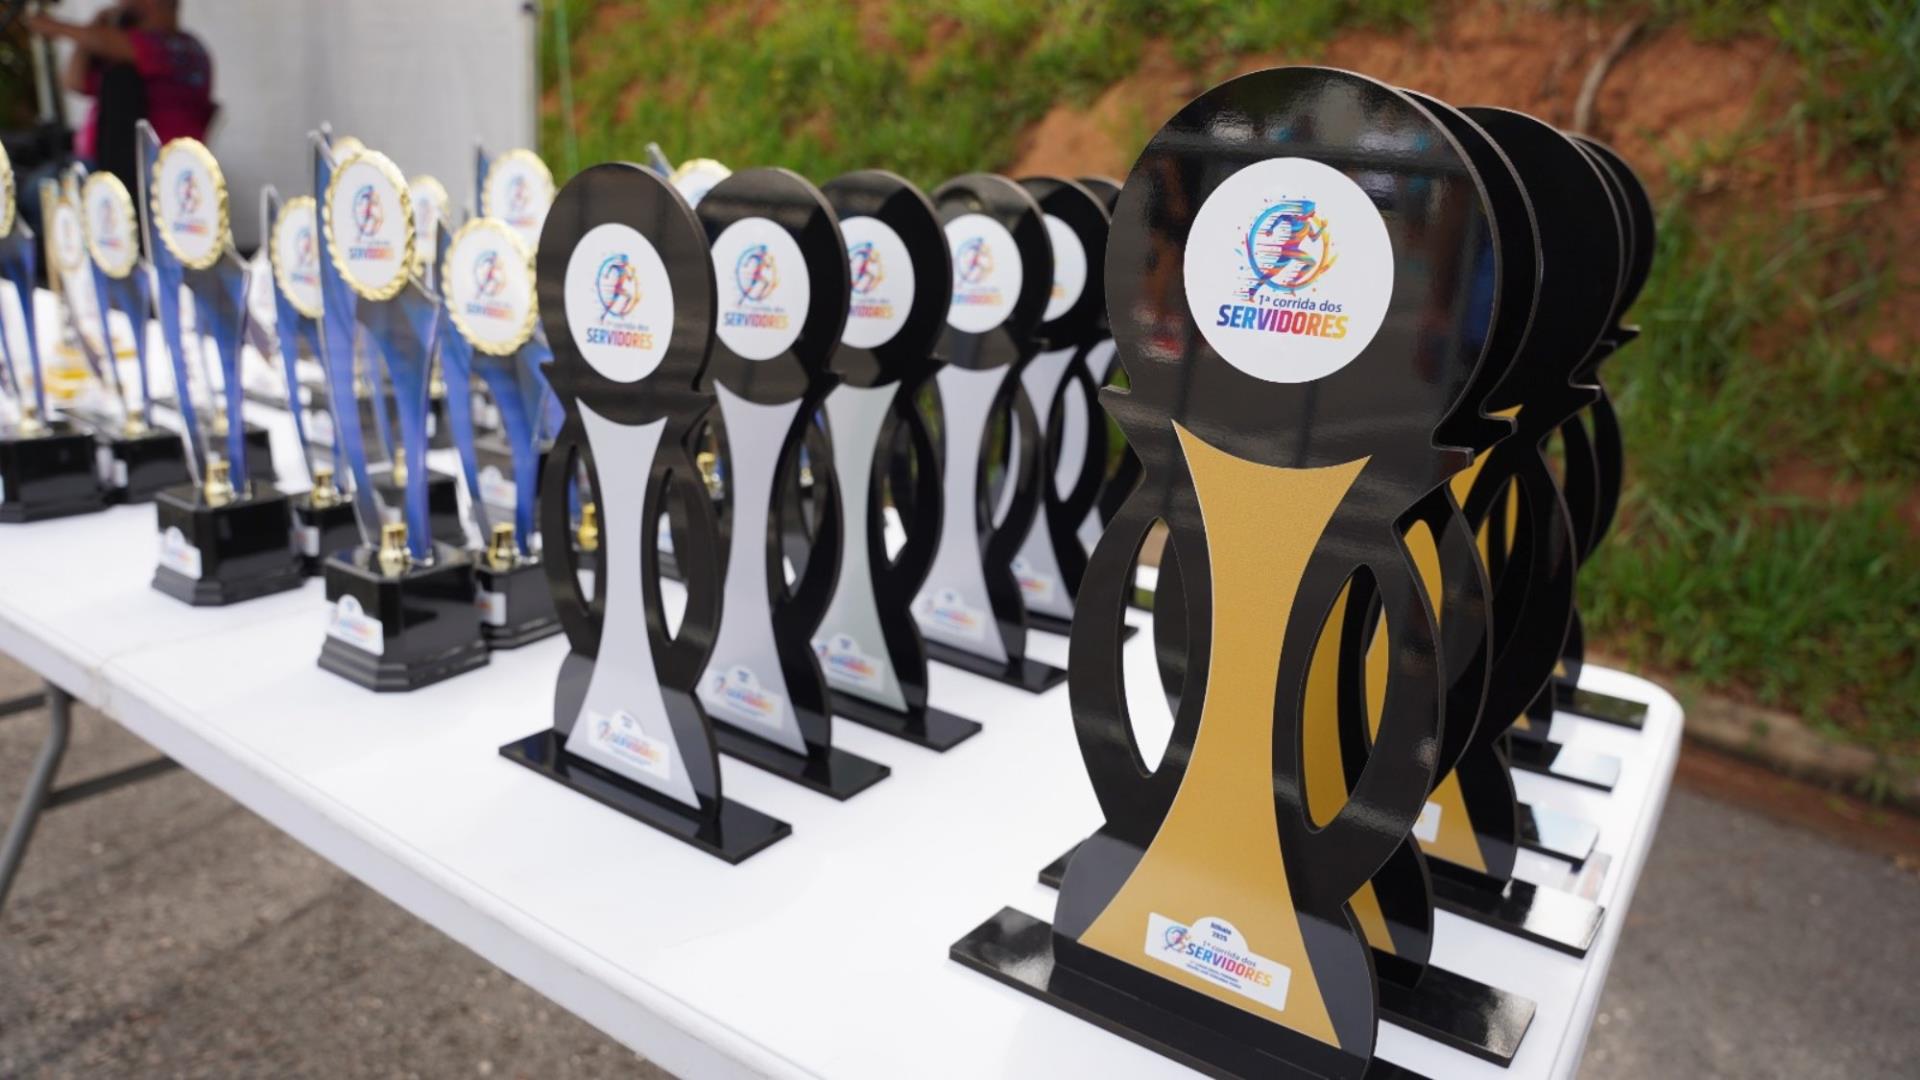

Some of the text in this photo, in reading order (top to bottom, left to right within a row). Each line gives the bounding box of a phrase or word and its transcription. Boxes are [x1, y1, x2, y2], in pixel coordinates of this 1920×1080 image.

[1259, 294, 1342, 313] 1ª corrida dos
[1216, 304, 1350, 339] SERVIDORES
[586, 328, 654, 350] SERVIDORES
[1185, 943, 1273, 987] SERVIDORES
[1241, 957, 1256, 967] dos
